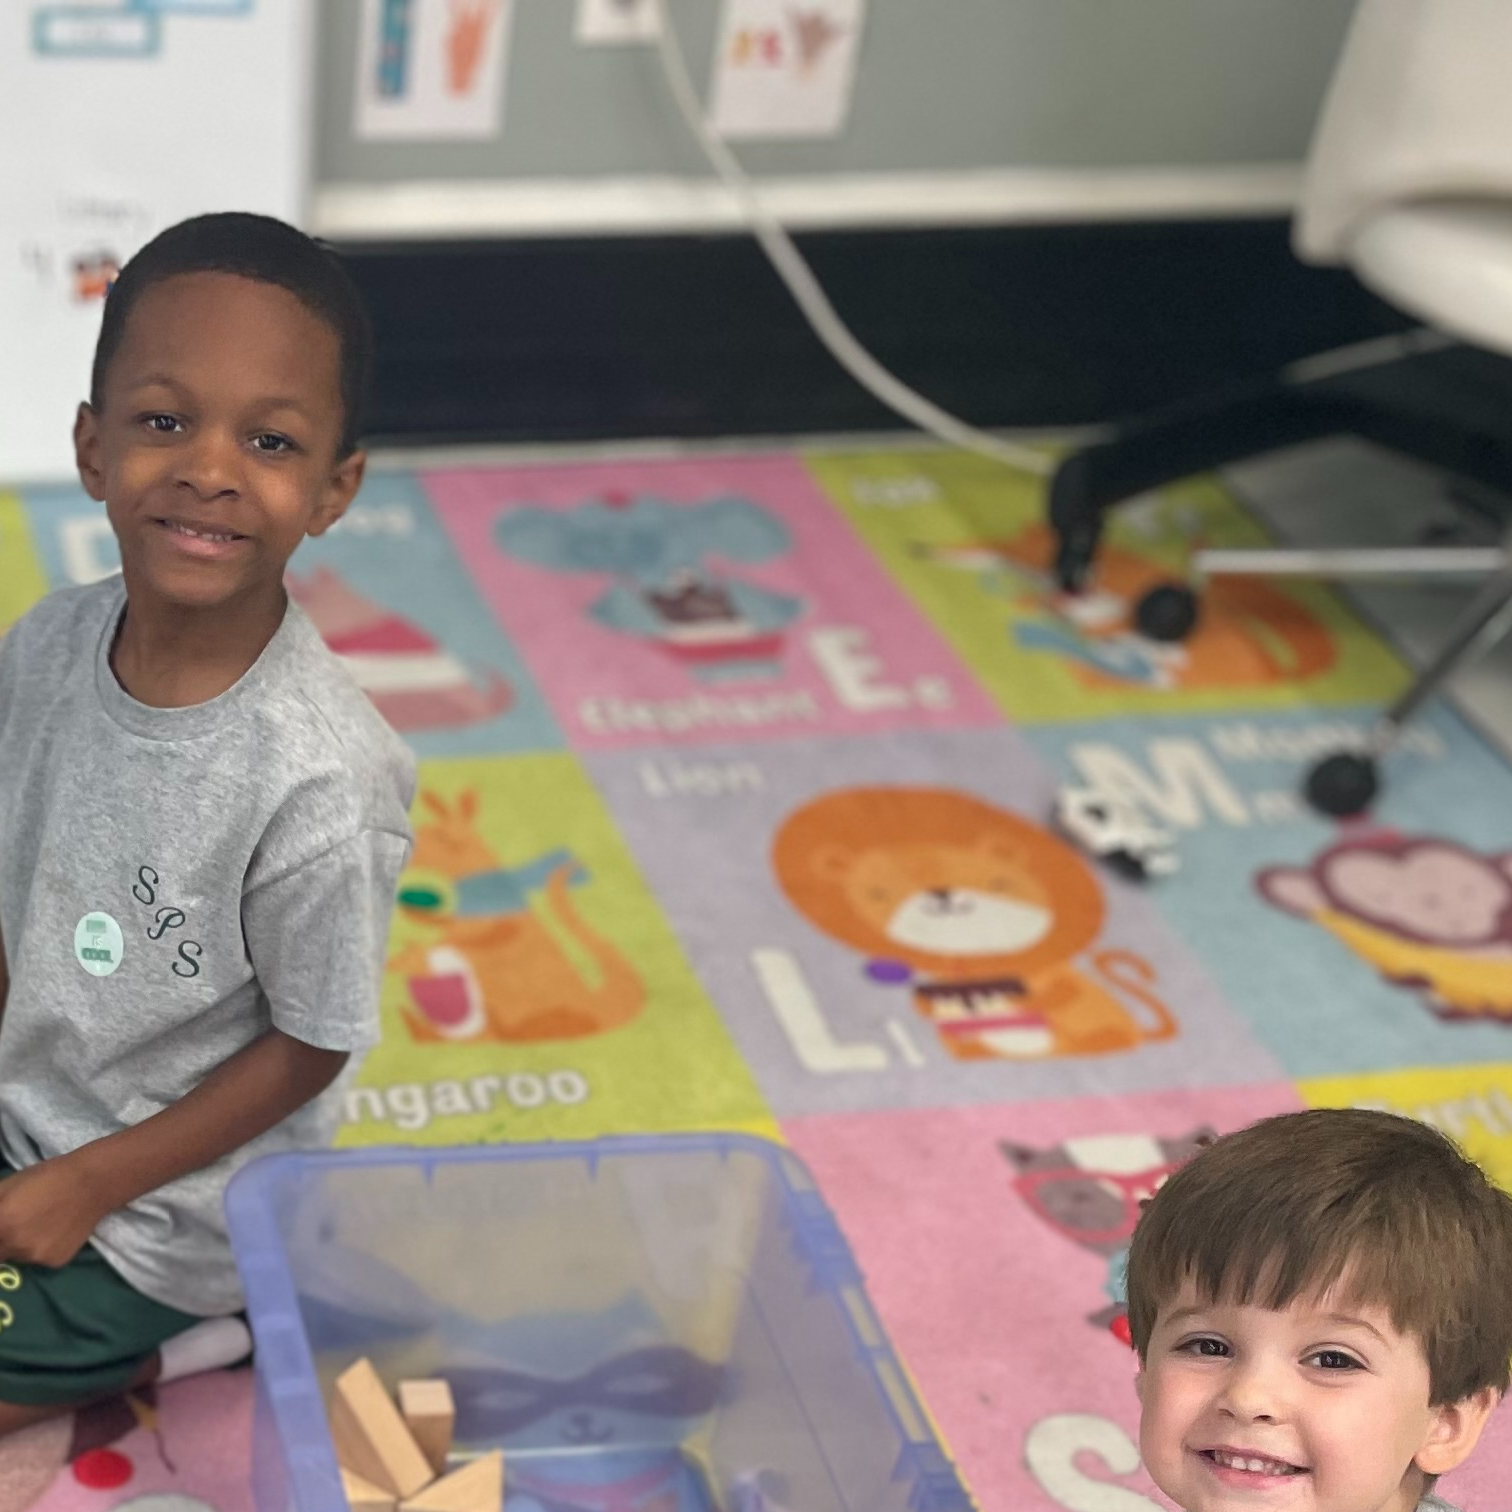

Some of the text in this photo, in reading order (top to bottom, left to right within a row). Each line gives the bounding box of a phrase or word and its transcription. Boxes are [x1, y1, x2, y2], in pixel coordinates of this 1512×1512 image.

[808, 626, 910, 711] E
[580, 692, 823, 734] Elephant
[638, 758, 761, 797] Lion
[1072, 737, 1250, 828] M
[132, 864, 205, 978] SPS
[749, 947, 886, 1074] L
[345, 1070, 587, 1130] ngaroo
